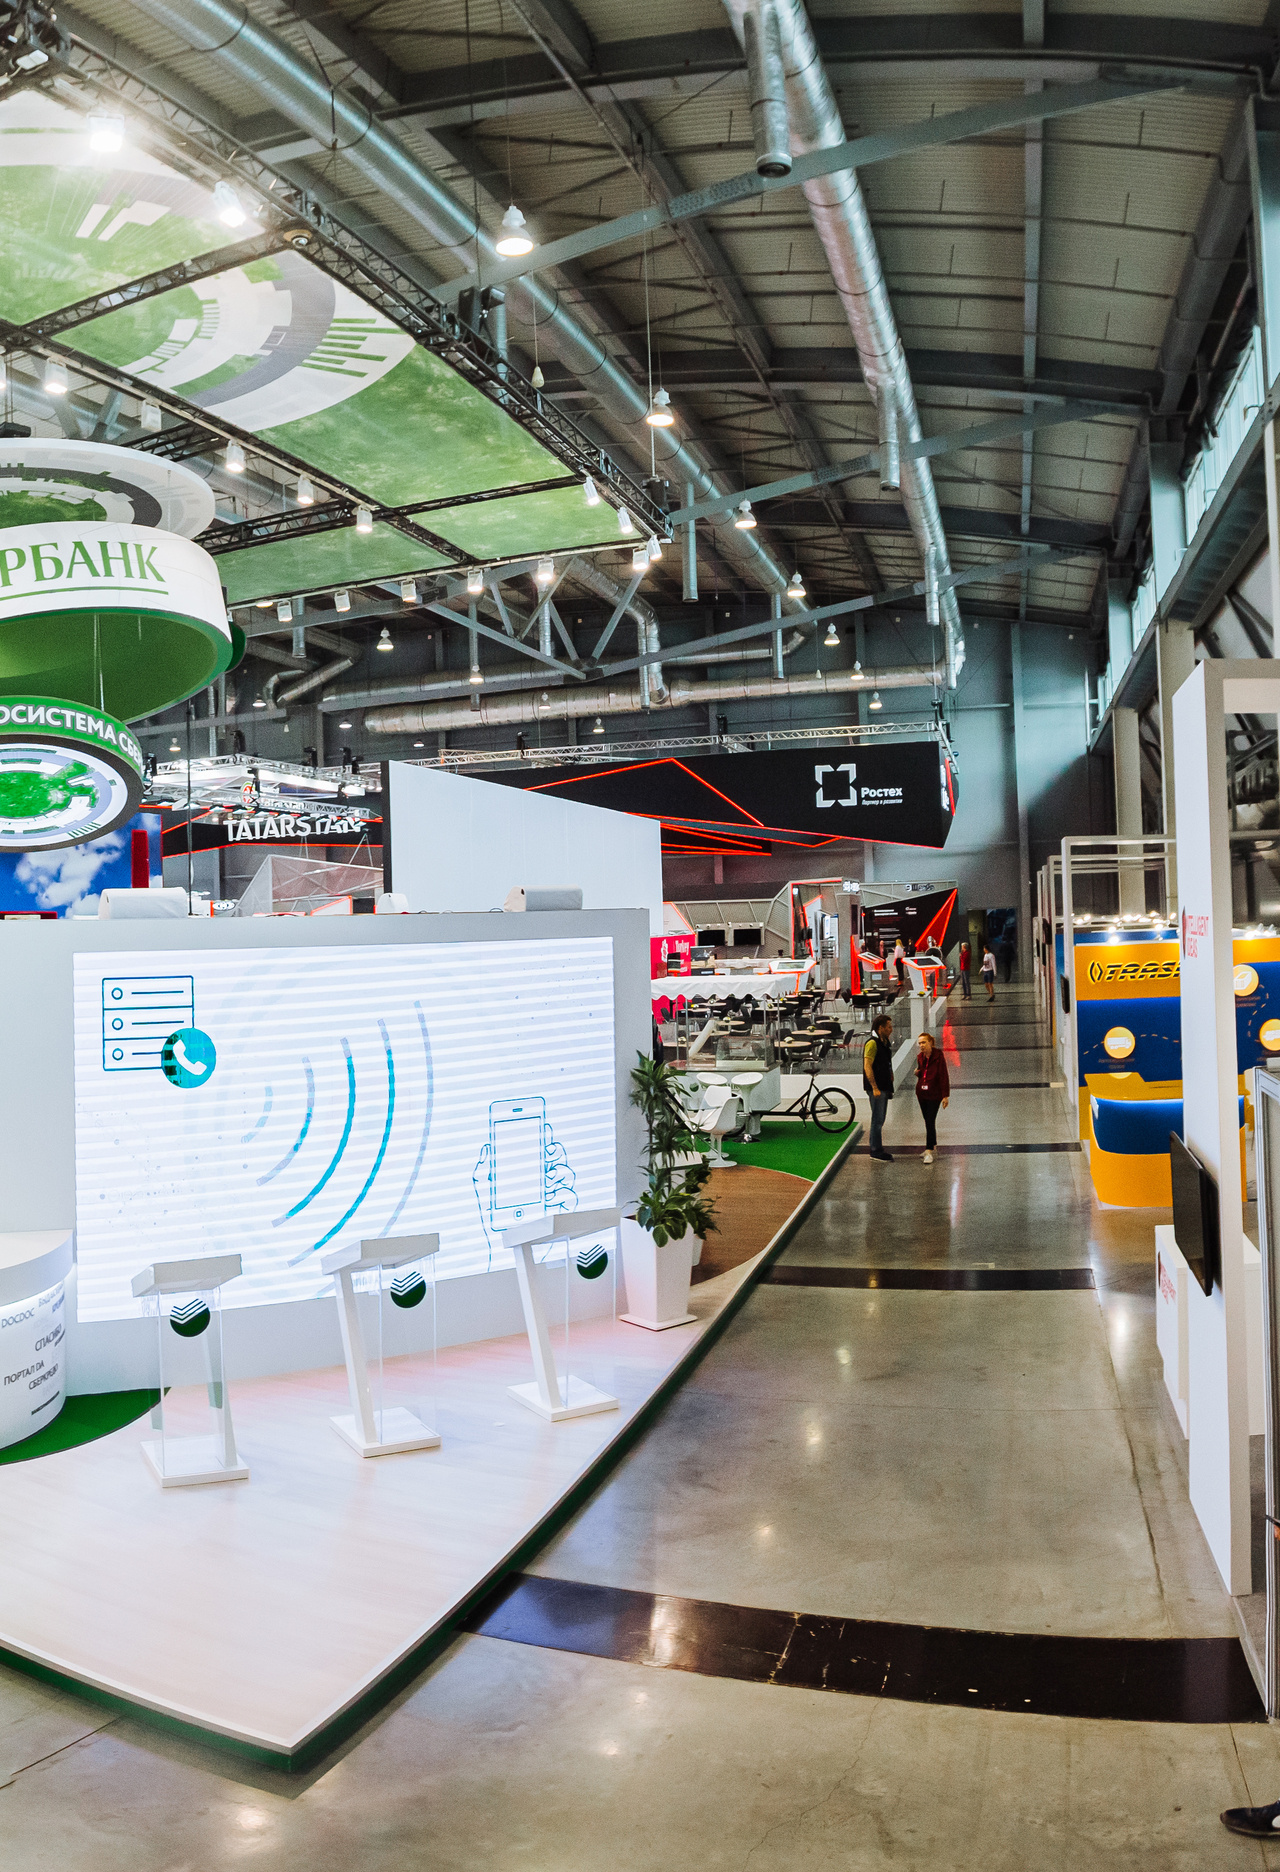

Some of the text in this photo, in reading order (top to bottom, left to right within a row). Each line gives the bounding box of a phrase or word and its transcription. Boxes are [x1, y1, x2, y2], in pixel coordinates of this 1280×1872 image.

[861, 787, 903, 798] Ростех
[222, 814, 363, 842] TATARSTAN
[1, 1307, 35, 1329] DOCDOC
[3, 1364, 36, 1386] ПОРТАЛ
